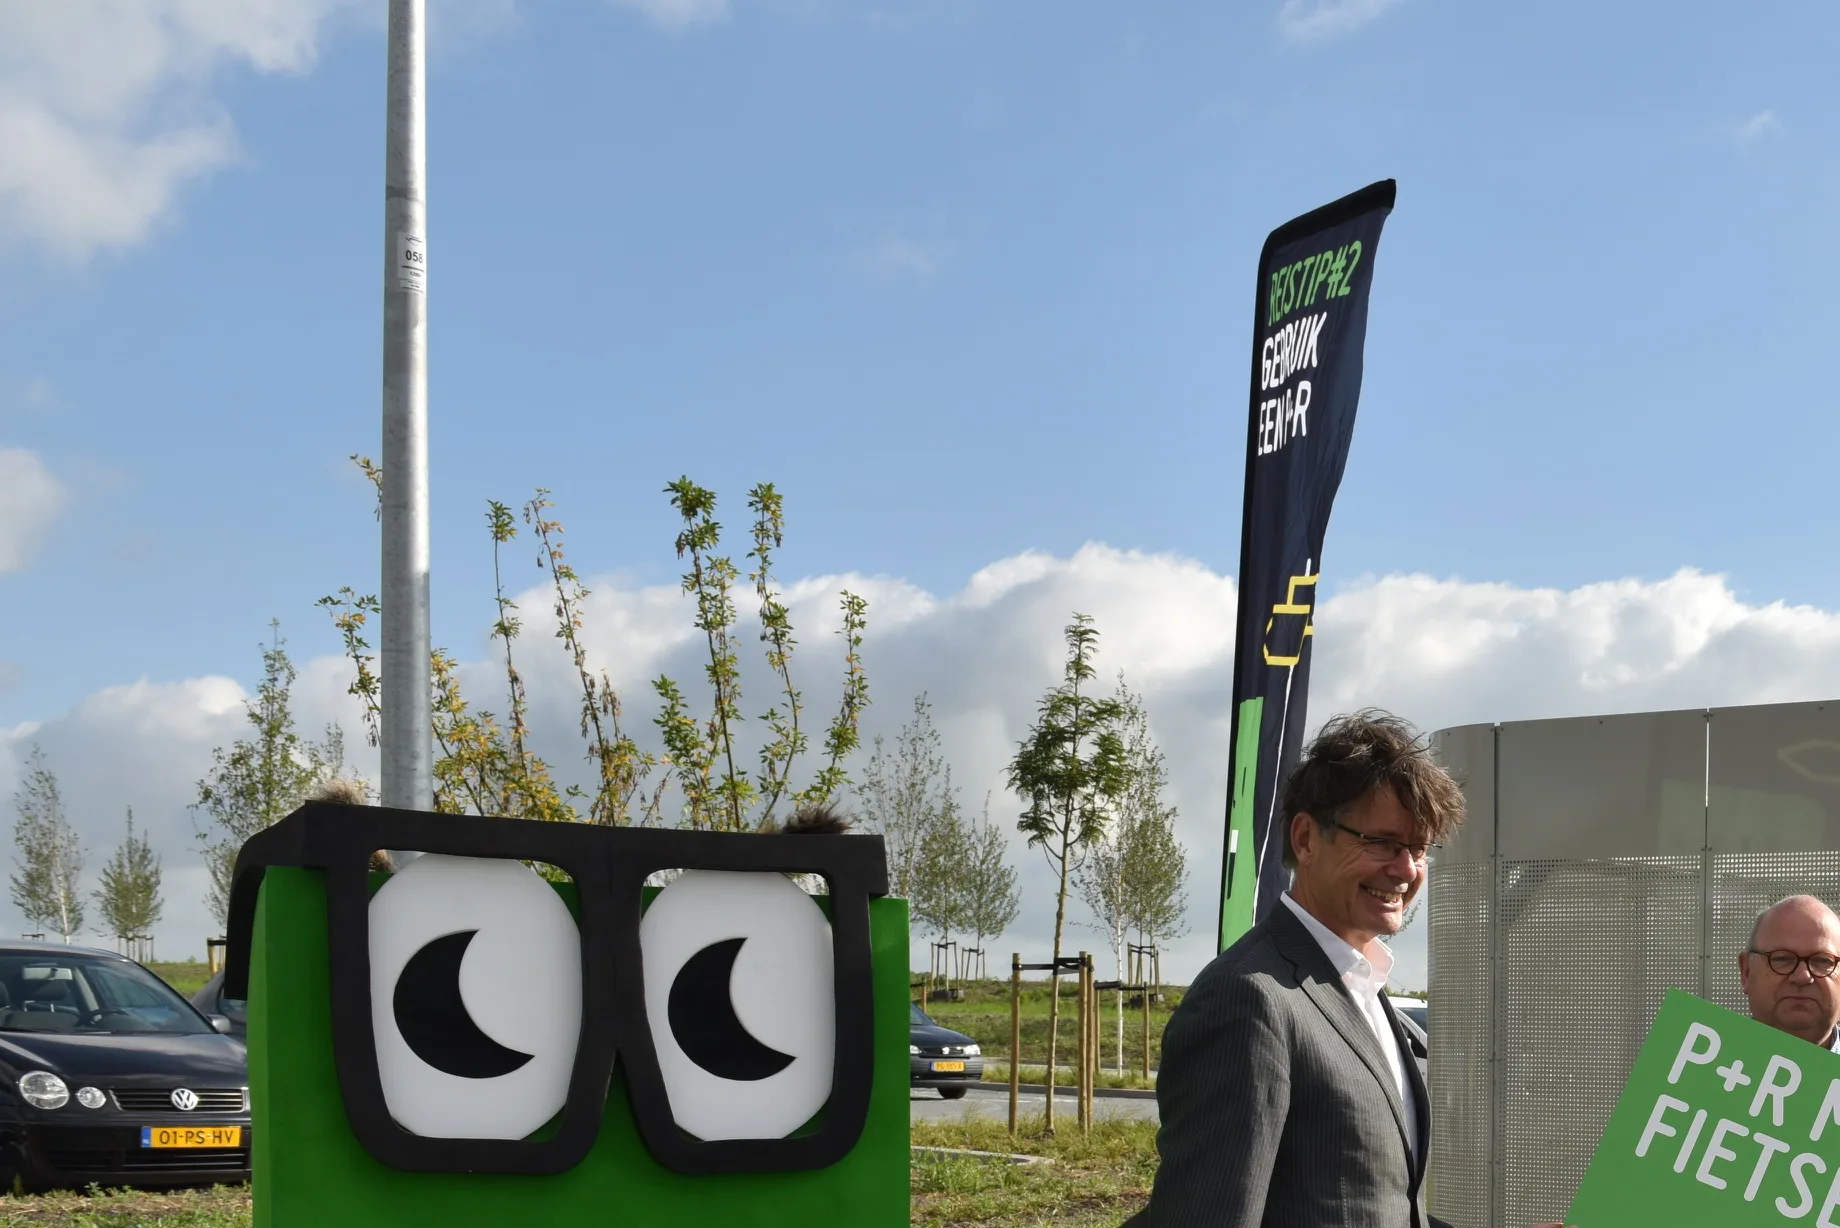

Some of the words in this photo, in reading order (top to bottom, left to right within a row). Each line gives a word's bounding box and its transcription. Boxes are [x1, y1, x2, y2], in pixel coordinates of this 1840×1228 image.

[405, 249, 424, 264] 058
[1268, 240, 1362, 327] REISTIP#2
[1262, 311, 1328, 391] GEBRUIK
[1667, 1021, 1802, 1127] P+R
[159, 1130, 234, 1145] 01-PS-HV
